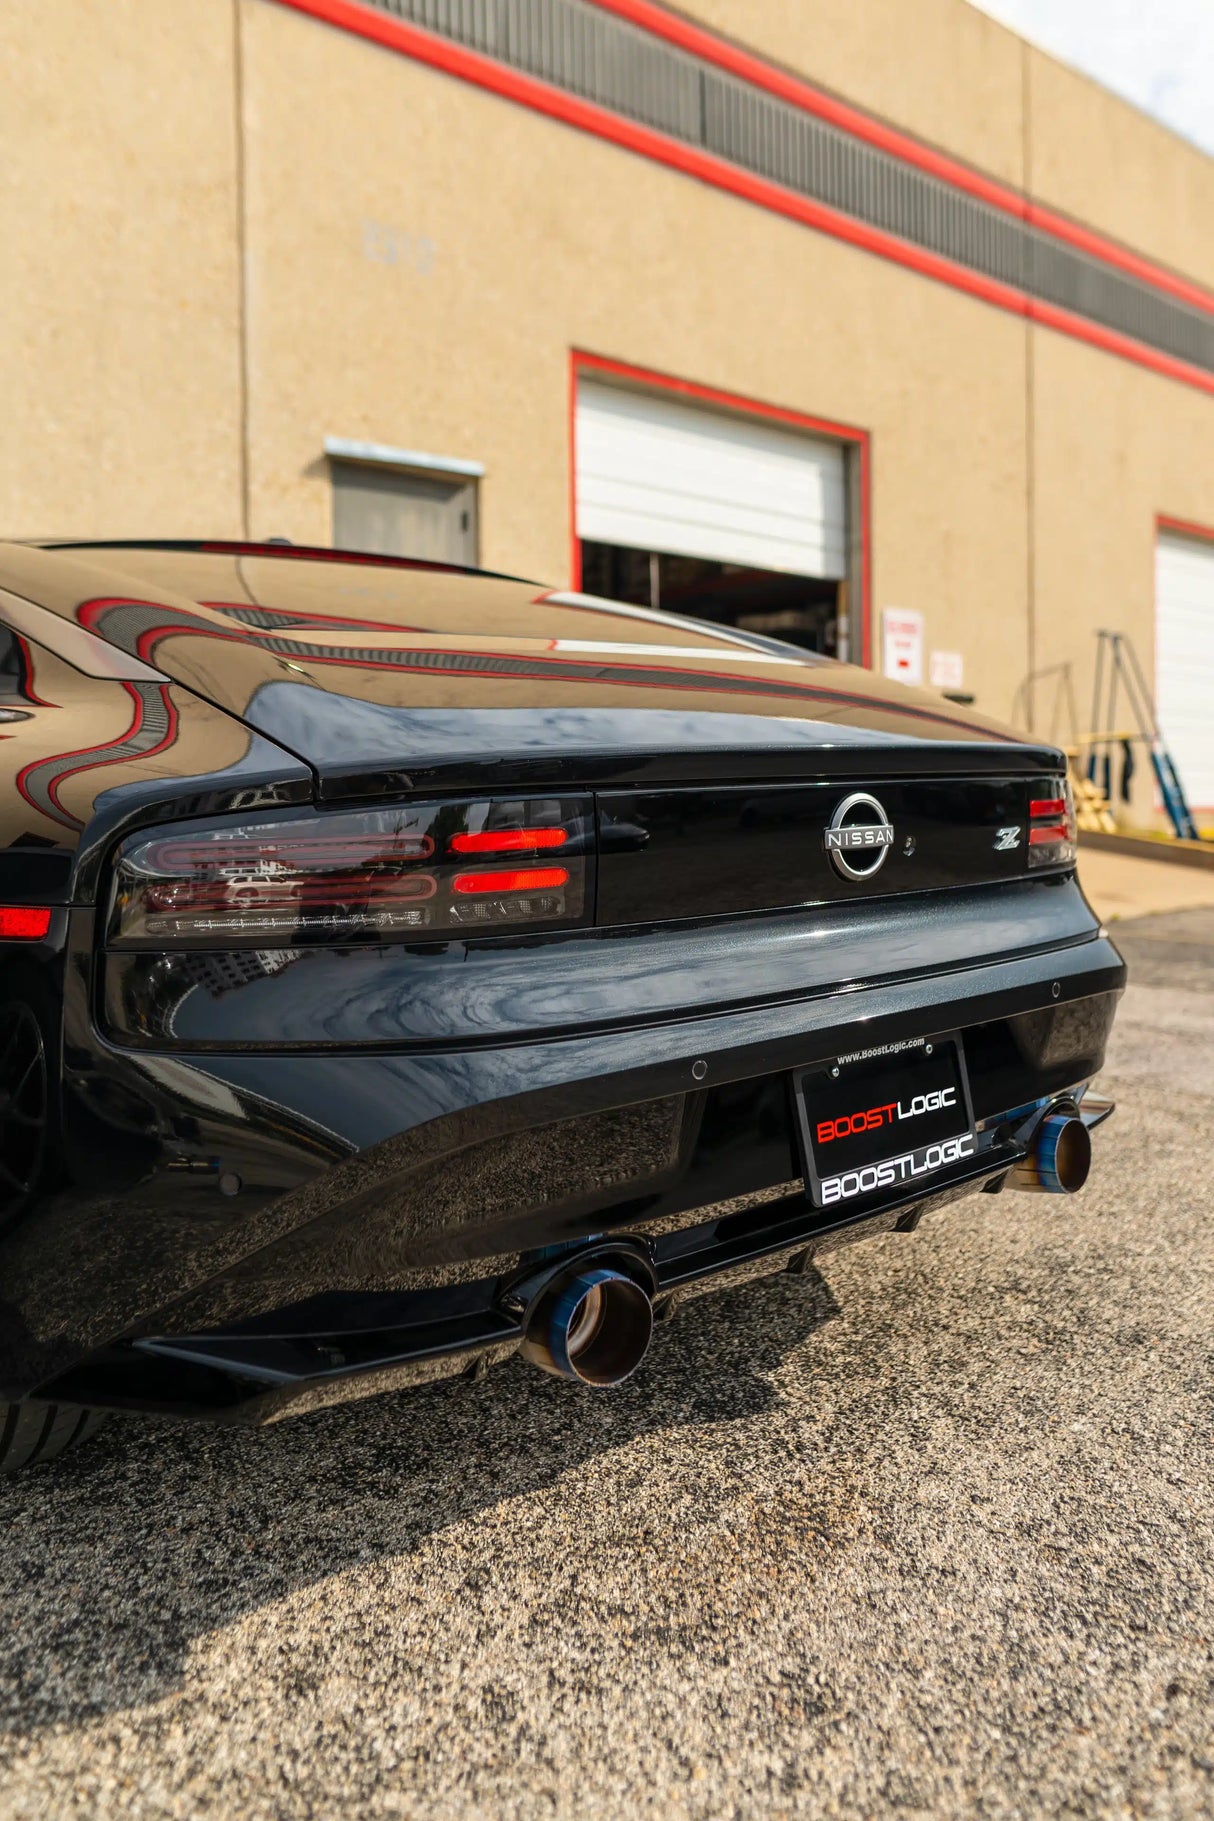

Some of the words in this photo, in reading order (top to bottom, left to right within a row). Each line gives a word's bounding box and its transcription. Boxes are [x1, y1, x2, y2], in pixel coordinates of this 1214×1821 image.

[828, 828, 894, 846] NISSAN
[993, 825, 1021, 851] Z
[837, 1037, 925, 1065] www.BoostLogic.com
[816, 1086, 957, 1144] BOOSTLOGIC
[821, 1133, 975, 1205] BOOSTLOGIC
